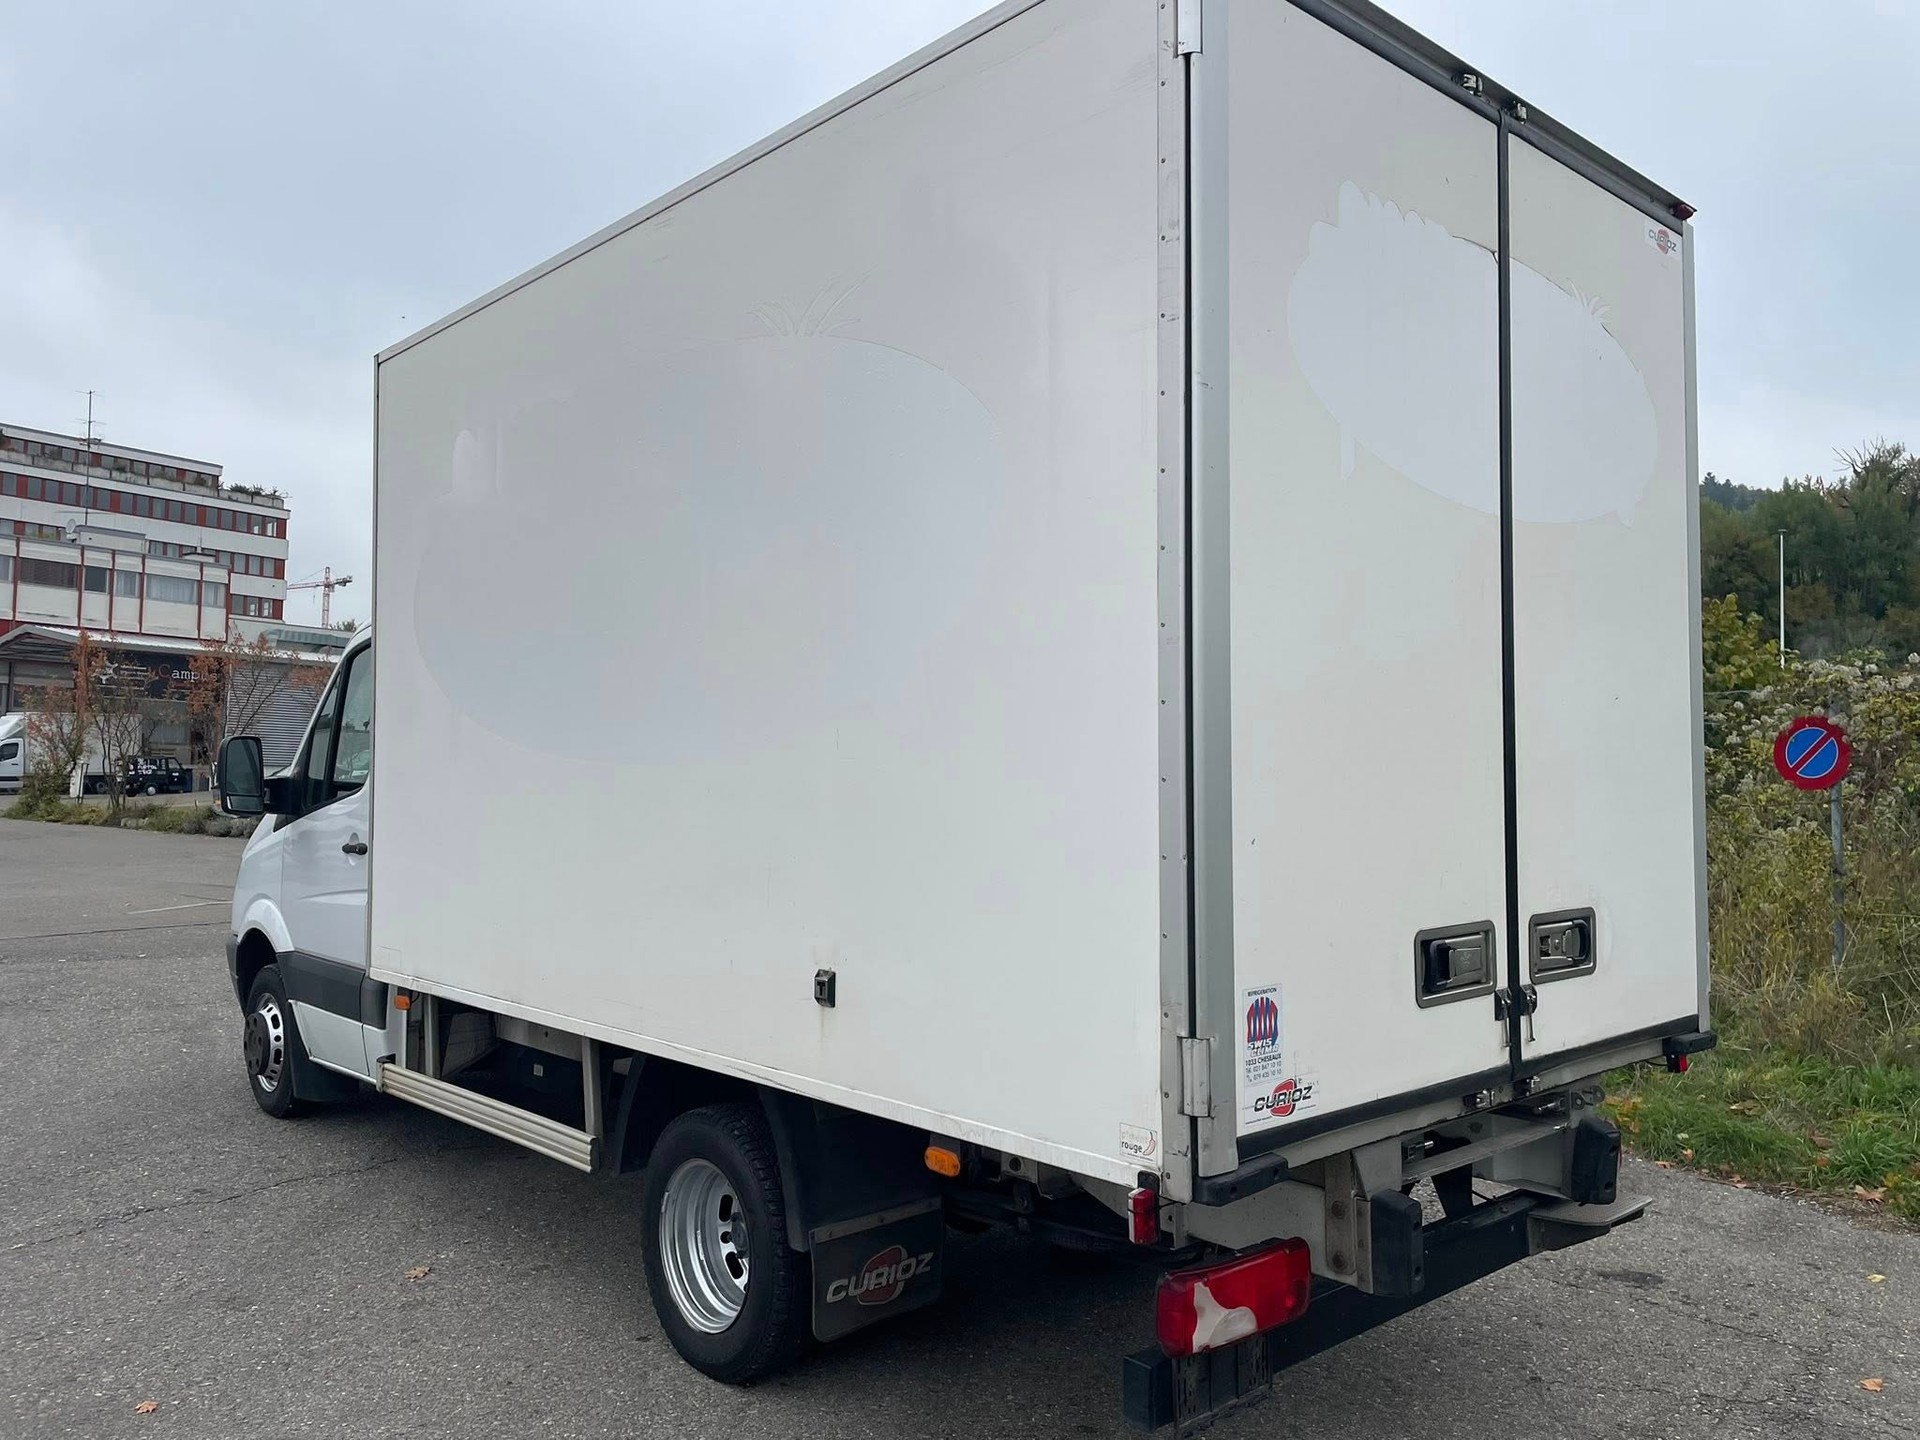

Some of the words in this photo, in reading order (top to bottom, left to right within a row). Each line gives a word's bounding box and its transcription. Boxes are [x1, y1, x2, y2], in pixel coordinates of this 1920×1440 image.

[1648, 229, 1677, 252] CURIOZ
[1245, 1057, 1257, 1067] 1033
[1257, 1053, 1282, 1064] CHESEAUX
[1254, 1085, 1313, 1112] CURIOZ
[1121, 1141, 1143, 1154] rouge
[826, 1252, 934, 1303] CURIOZ
